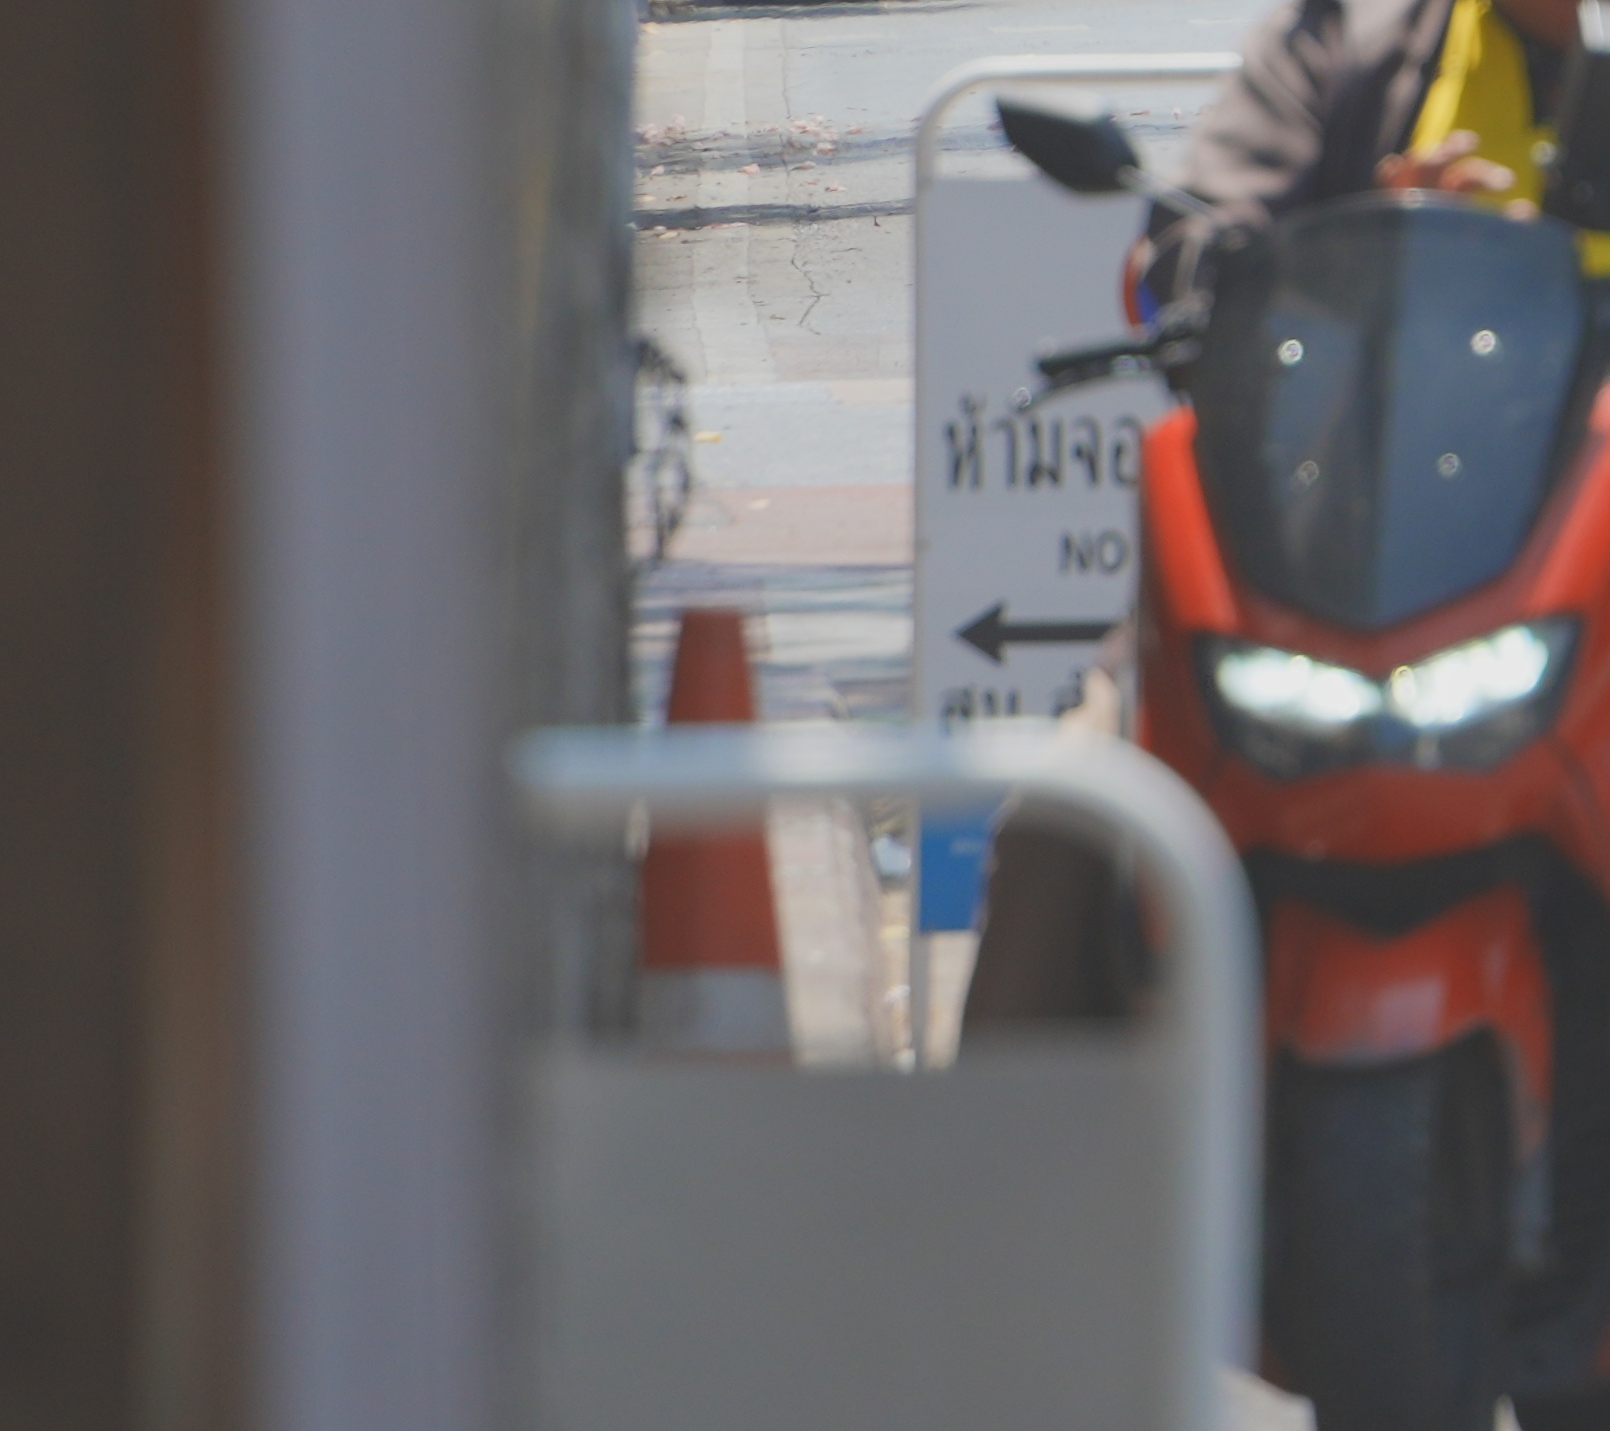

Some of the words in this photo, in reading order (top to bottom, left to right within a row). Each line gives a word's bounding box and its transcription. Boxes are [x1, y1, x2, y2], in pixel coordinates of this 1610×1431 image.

[943, 392, 1142, 491] ห้ามจอ
[1059, 530, 1129, 575] NO
